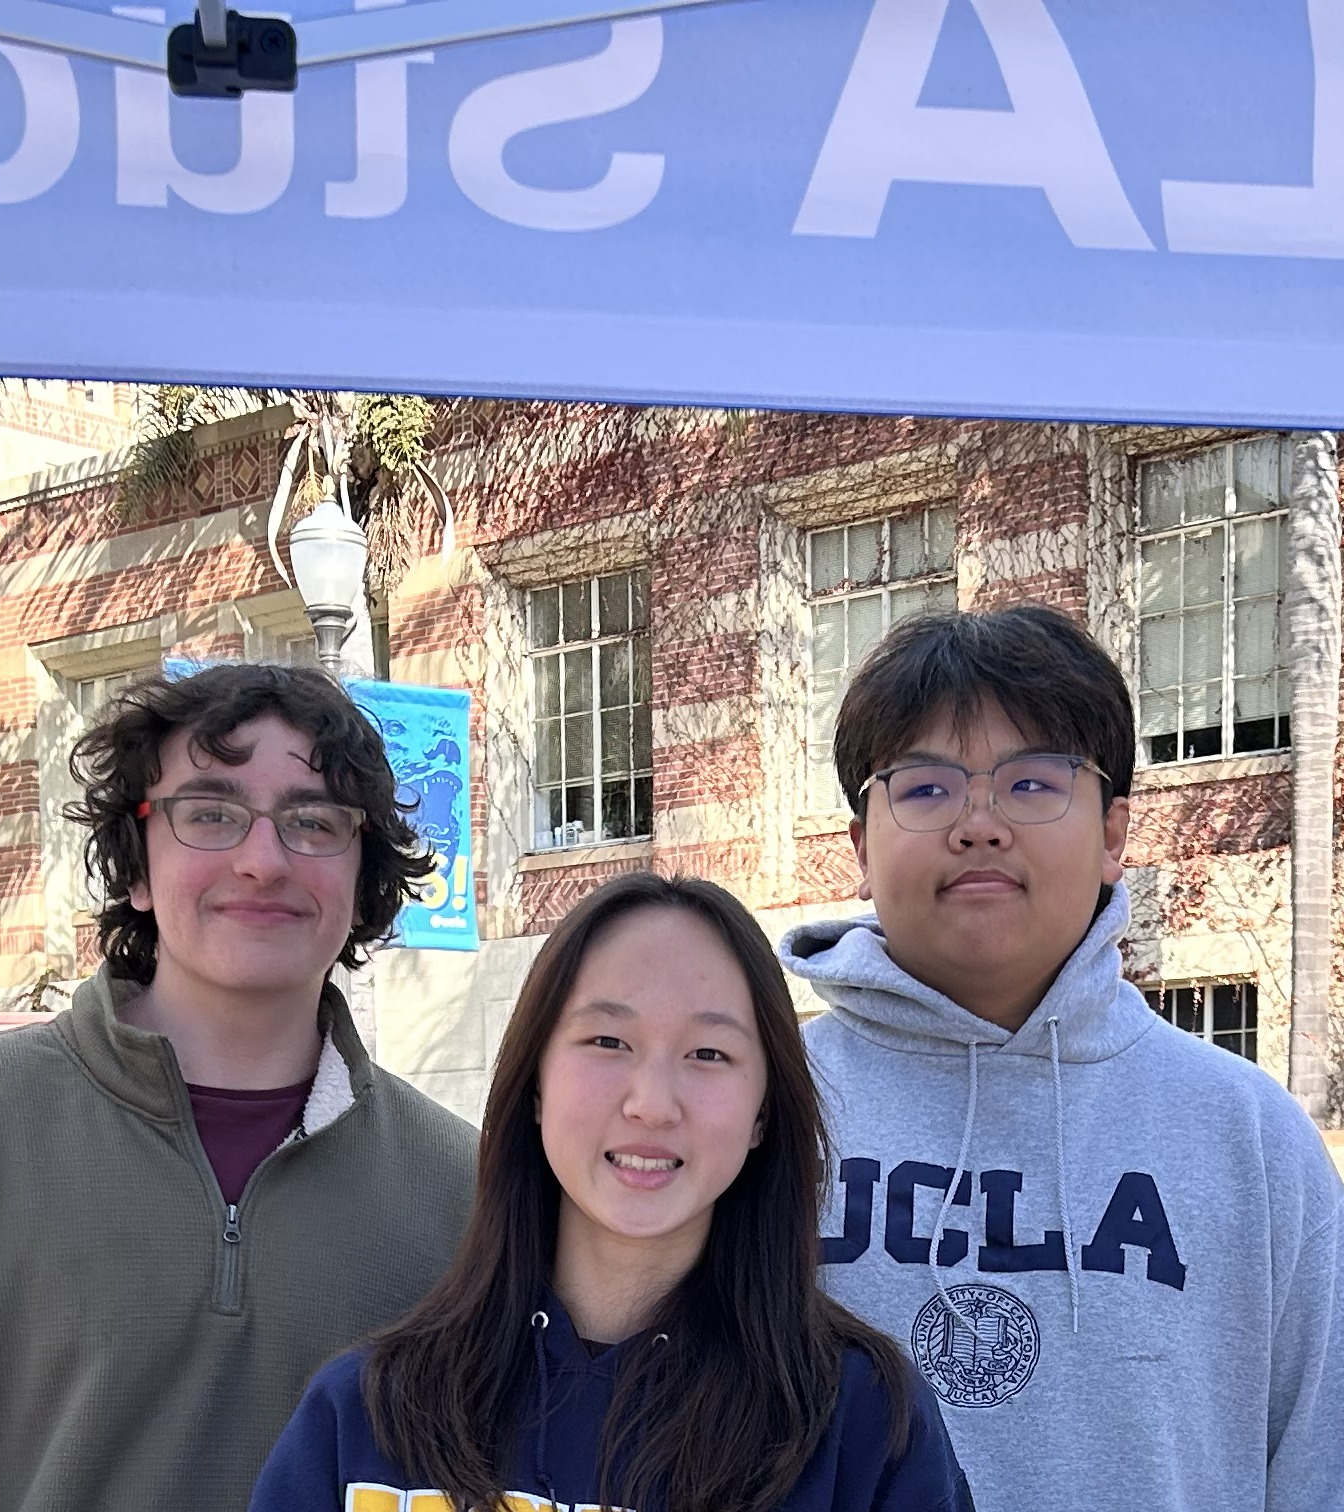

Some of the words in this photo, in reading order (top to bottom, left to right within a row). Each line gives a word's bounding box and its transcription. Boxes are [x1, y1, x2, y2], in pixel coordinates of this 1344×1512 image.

[917, 1289, 976, 1342] UNIVESITY
[986, 1292, 1006, 1307] OF
[1010, 1306, 1034, 1384] CALIFORNIA
[953, 1390, 991, 1401] UCLA
